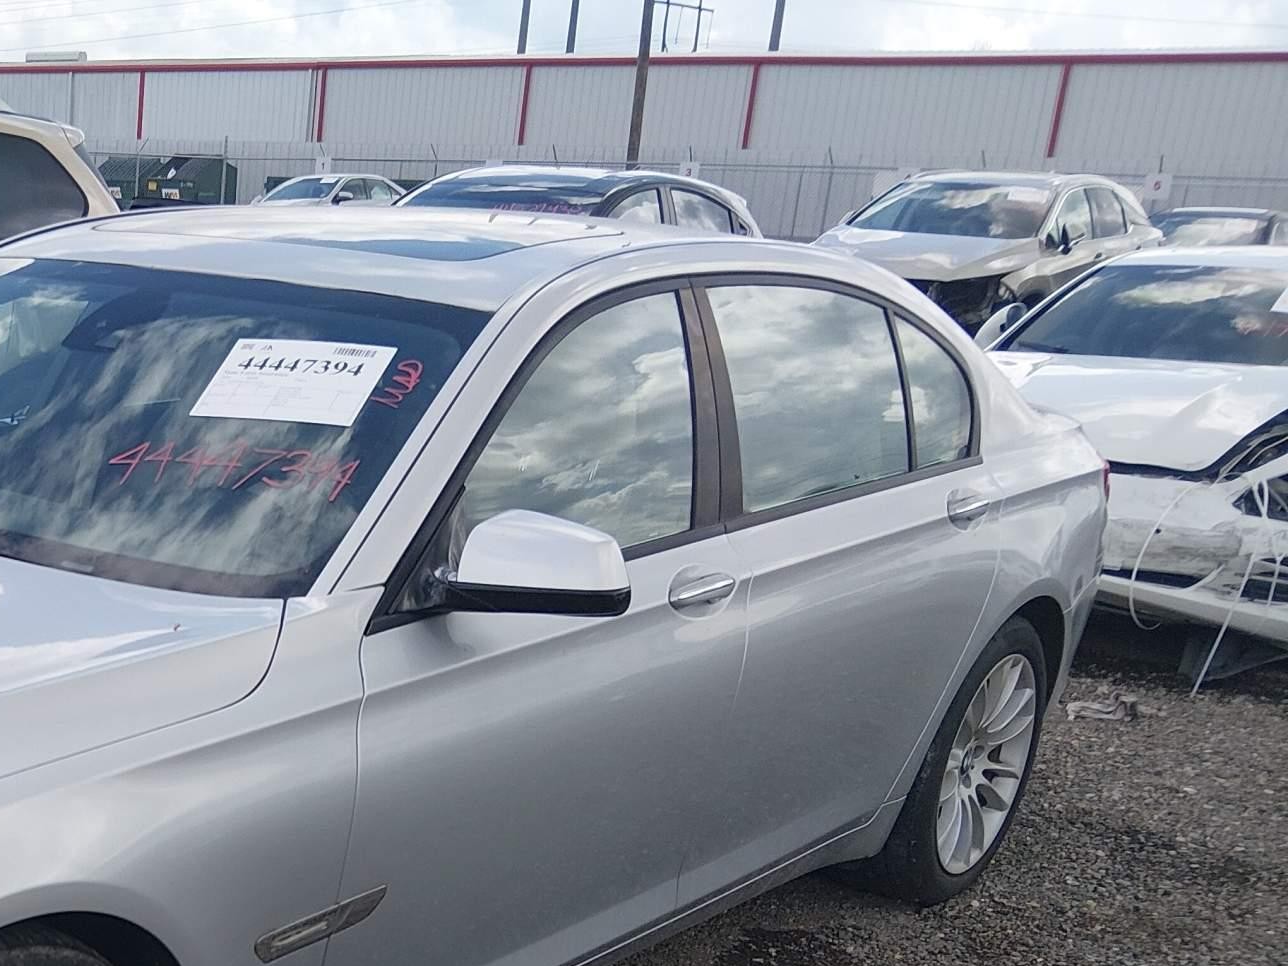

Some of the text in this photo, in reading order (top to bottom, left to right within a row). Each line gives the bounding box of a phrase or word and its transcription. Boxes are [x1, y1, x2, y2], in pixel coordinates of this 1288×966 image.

[684, 168, 692, 177] 3
[237, 356, 364, 376] 44447394
[108, 439, 360, 502] 44447394
